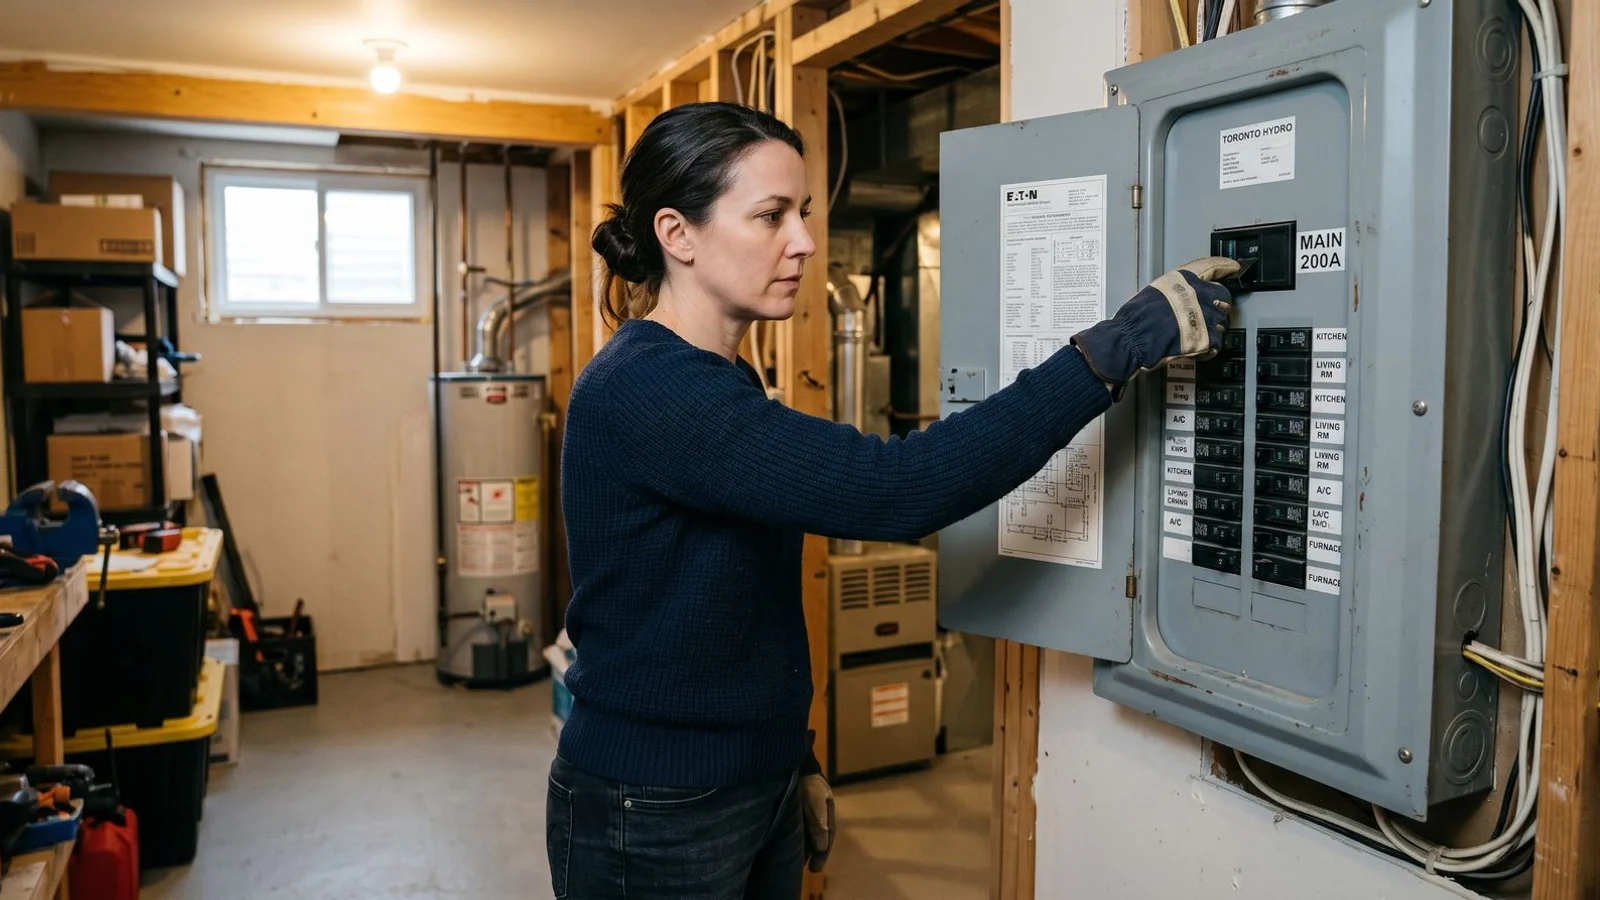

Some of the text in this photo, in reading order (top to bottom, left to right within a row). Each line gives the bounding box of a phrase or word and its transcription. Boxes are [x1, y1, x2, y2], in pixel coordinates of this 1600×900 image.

[1222, 123, 1293, 144] TORONTO HYDRO
[1300, 231, 1342, 250] MAIN
[1300, 252, 1341, 270] 200A
[1316, 332, 1347, 341] KITCHEN
[1316, 361, 1341, 369] LIVING
[1315, 394, 1346, 403] KITCHEN
[1172, 415, 1186, 424] A/C
[1315, 421, 1340, 431] LIVING
[1317, 431, 1330, 439] RM
[1316, 461, 1329, 470] RM
[1167, 466, 1192, 476] KITCHEN
[1316, 485, 1331, 495] A/C
[1169, 517, 1182, 526] A/C
[1308, 573, 1340, 587] FURNACE
